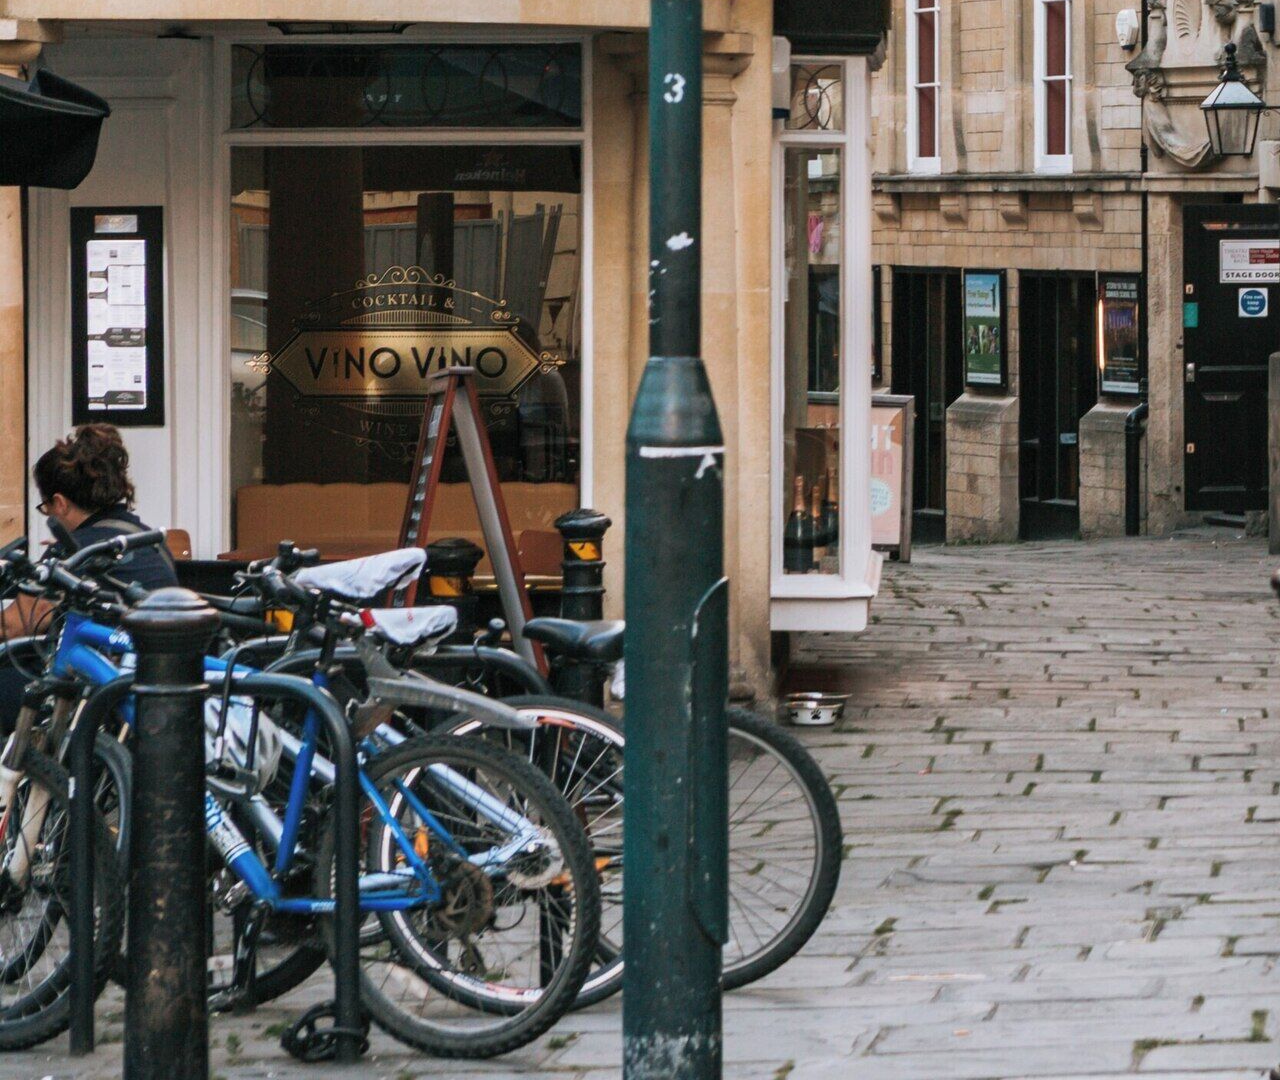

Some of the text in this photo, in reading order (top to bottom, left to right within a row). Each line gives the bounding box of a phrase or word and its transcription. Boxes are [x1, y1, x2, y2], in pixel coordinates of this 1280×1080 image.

[664, 72, 687, 103] 3
[352, 292, 456, 309] COCKTAIL &
[304, 346, 508, 380] VINO VINO
[360, 420, 408, 438] WINE
